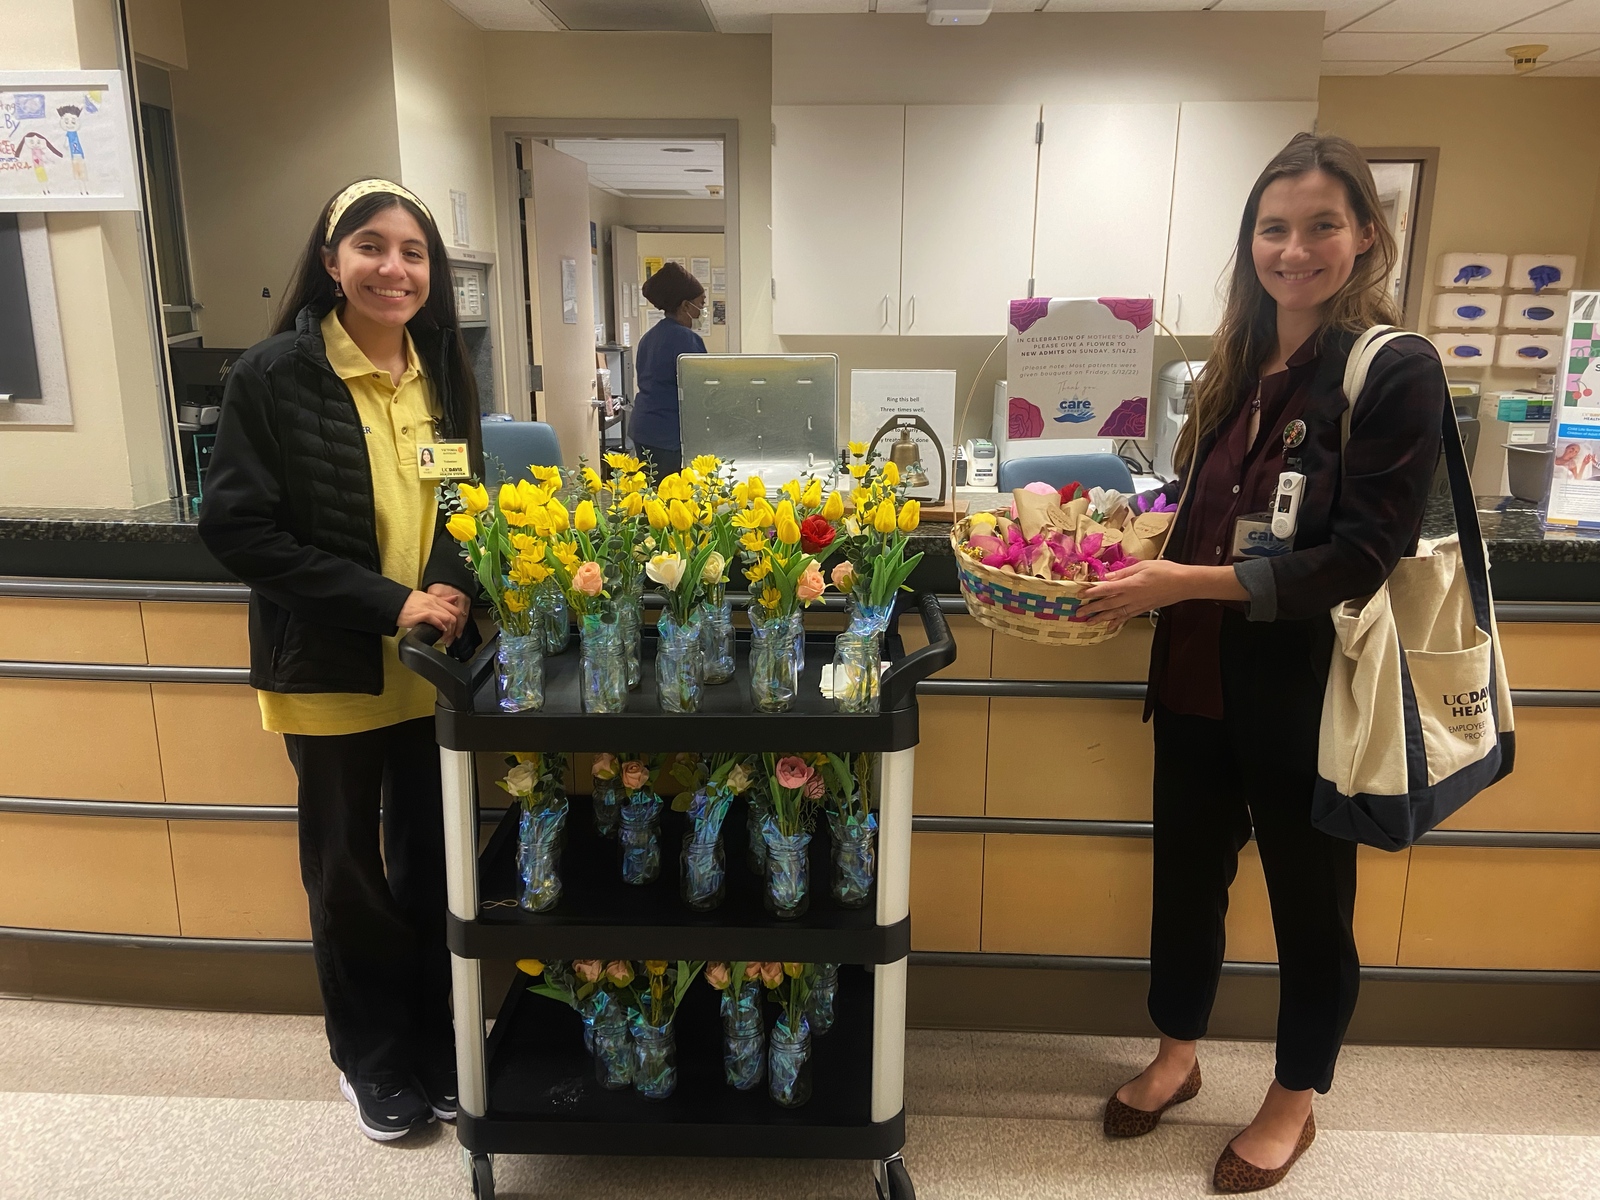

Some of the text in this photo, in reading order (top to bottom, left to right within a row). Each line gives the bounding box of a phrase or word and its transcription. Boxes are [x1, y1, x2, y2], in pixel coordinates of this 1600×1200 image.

[4, 113, 20, 138] By
[1026, 335, 1074, 343] CELEBRATION
[1058, 380, 1080, 394] Thank
[1059, 400, 1092, 409] care
